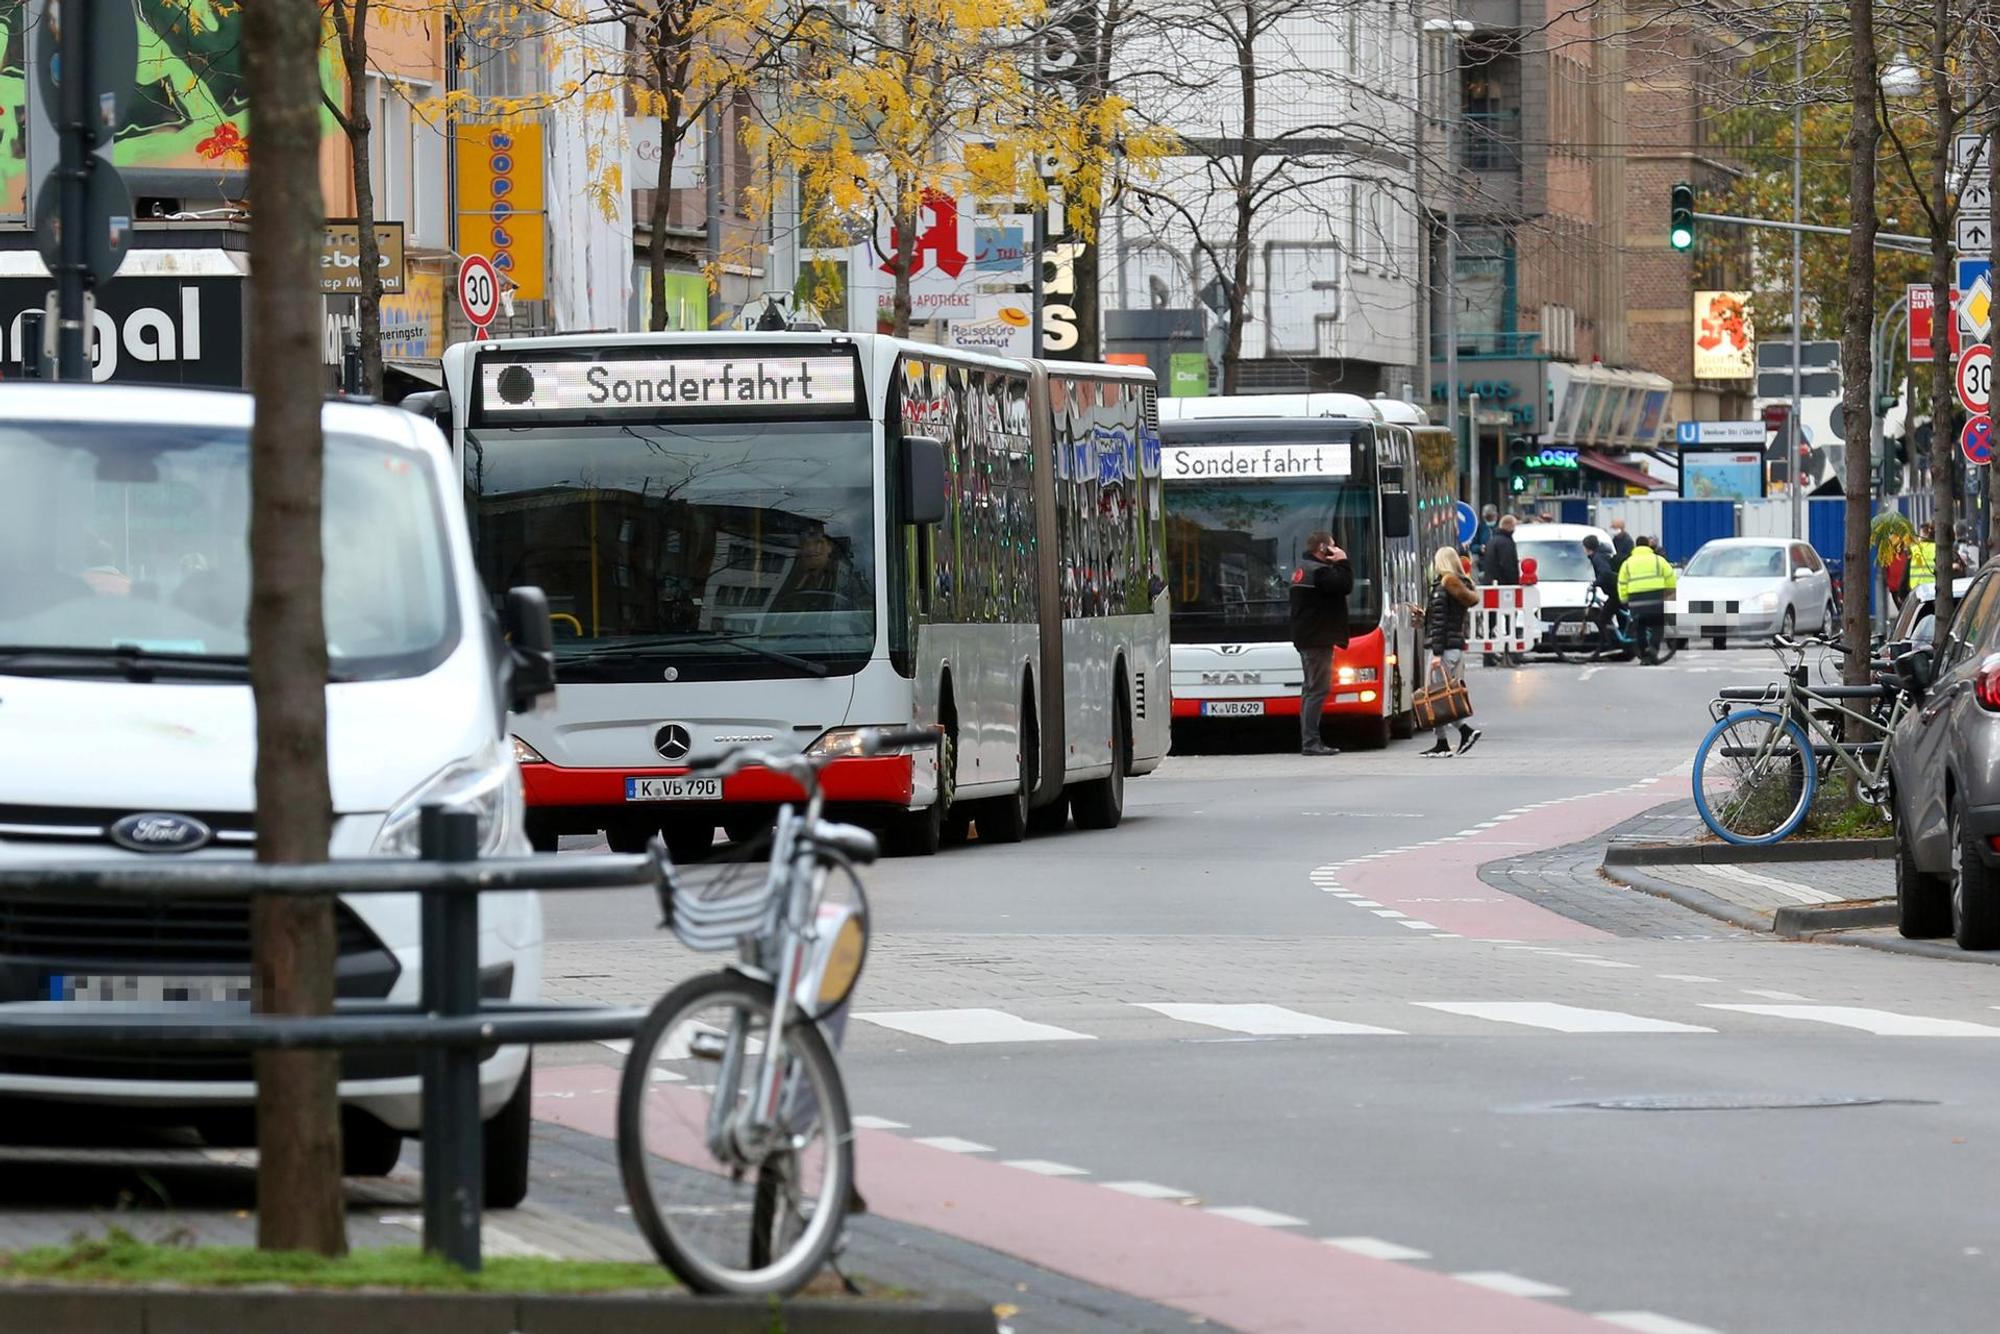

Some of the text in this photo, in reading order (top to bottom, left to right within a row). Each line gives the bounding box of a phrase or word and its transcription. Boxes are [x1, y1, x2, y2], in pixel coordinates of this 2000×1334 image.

[467, 274, 490, 307] 30
[951, 324, 1016, 337] Reisebüro
[586, 361, 813, 403] Sonderfahrt
[1967, 365, 1992, 394] 30
[1681, 424, 1696, 441] U
[1175, 448, 1323, 475] Sonderfahrt
[1201, 670, 1262, 685] MAN
[1211, 703, 1260, 714] K VB 629
[642, 780, 652, 796] K
[686, 780, 715, 796] 790
[132, 819, 189, 841] Ford
